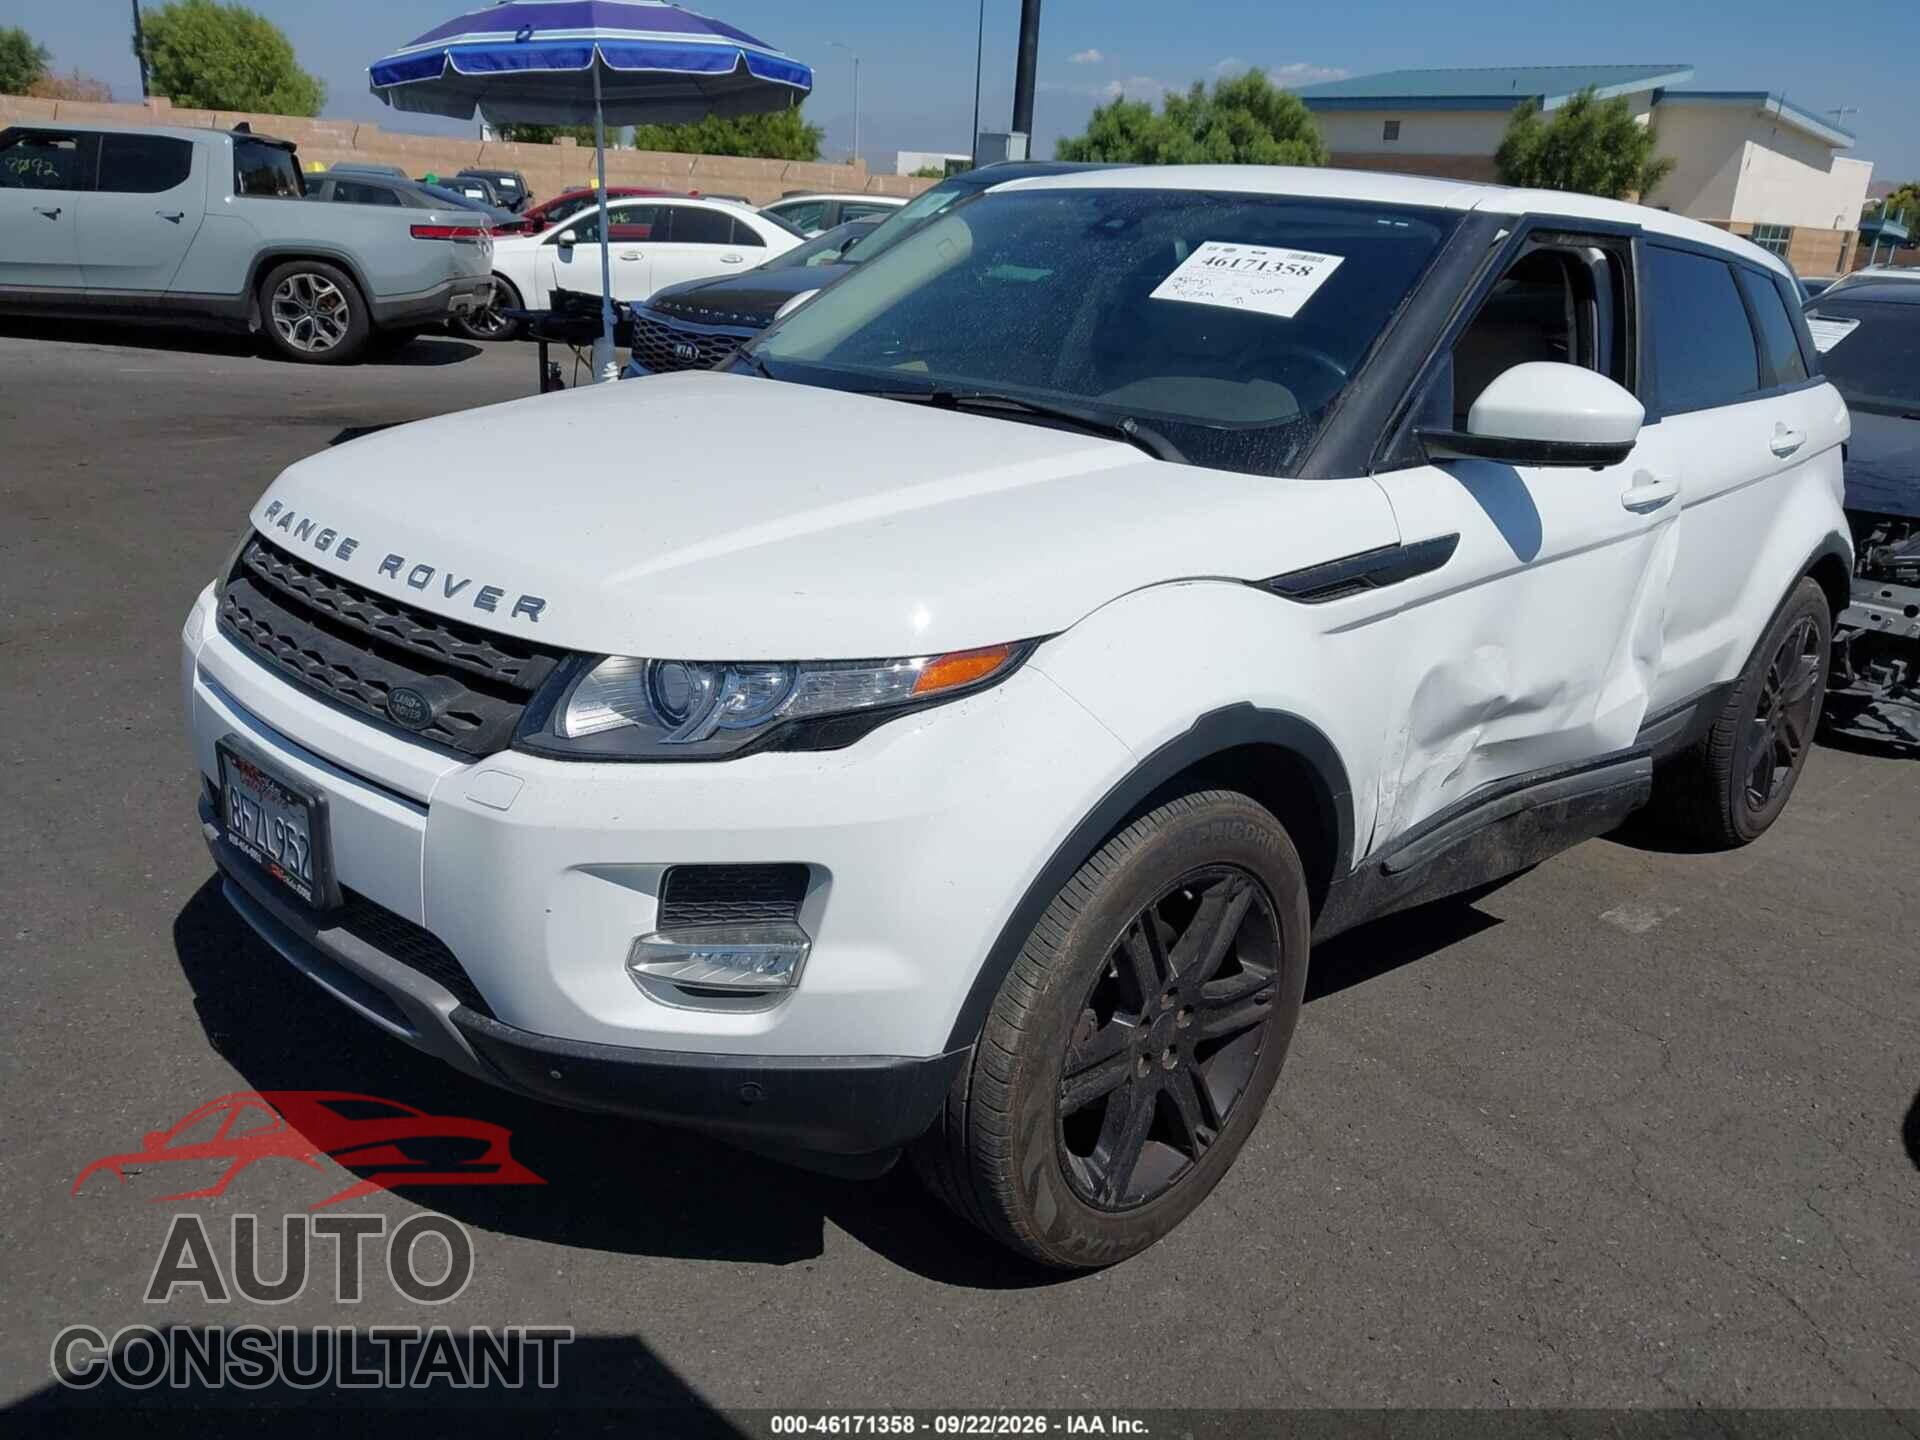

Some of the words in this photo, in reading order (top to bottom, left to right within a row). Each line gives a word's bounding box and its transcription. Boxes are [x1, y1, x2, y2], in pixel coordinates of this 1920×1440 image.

[1201, 254, 1315, 278] 46171358
[264, 500, 360, 562] RANGE
[378, 553, 547, 622] ROVER
